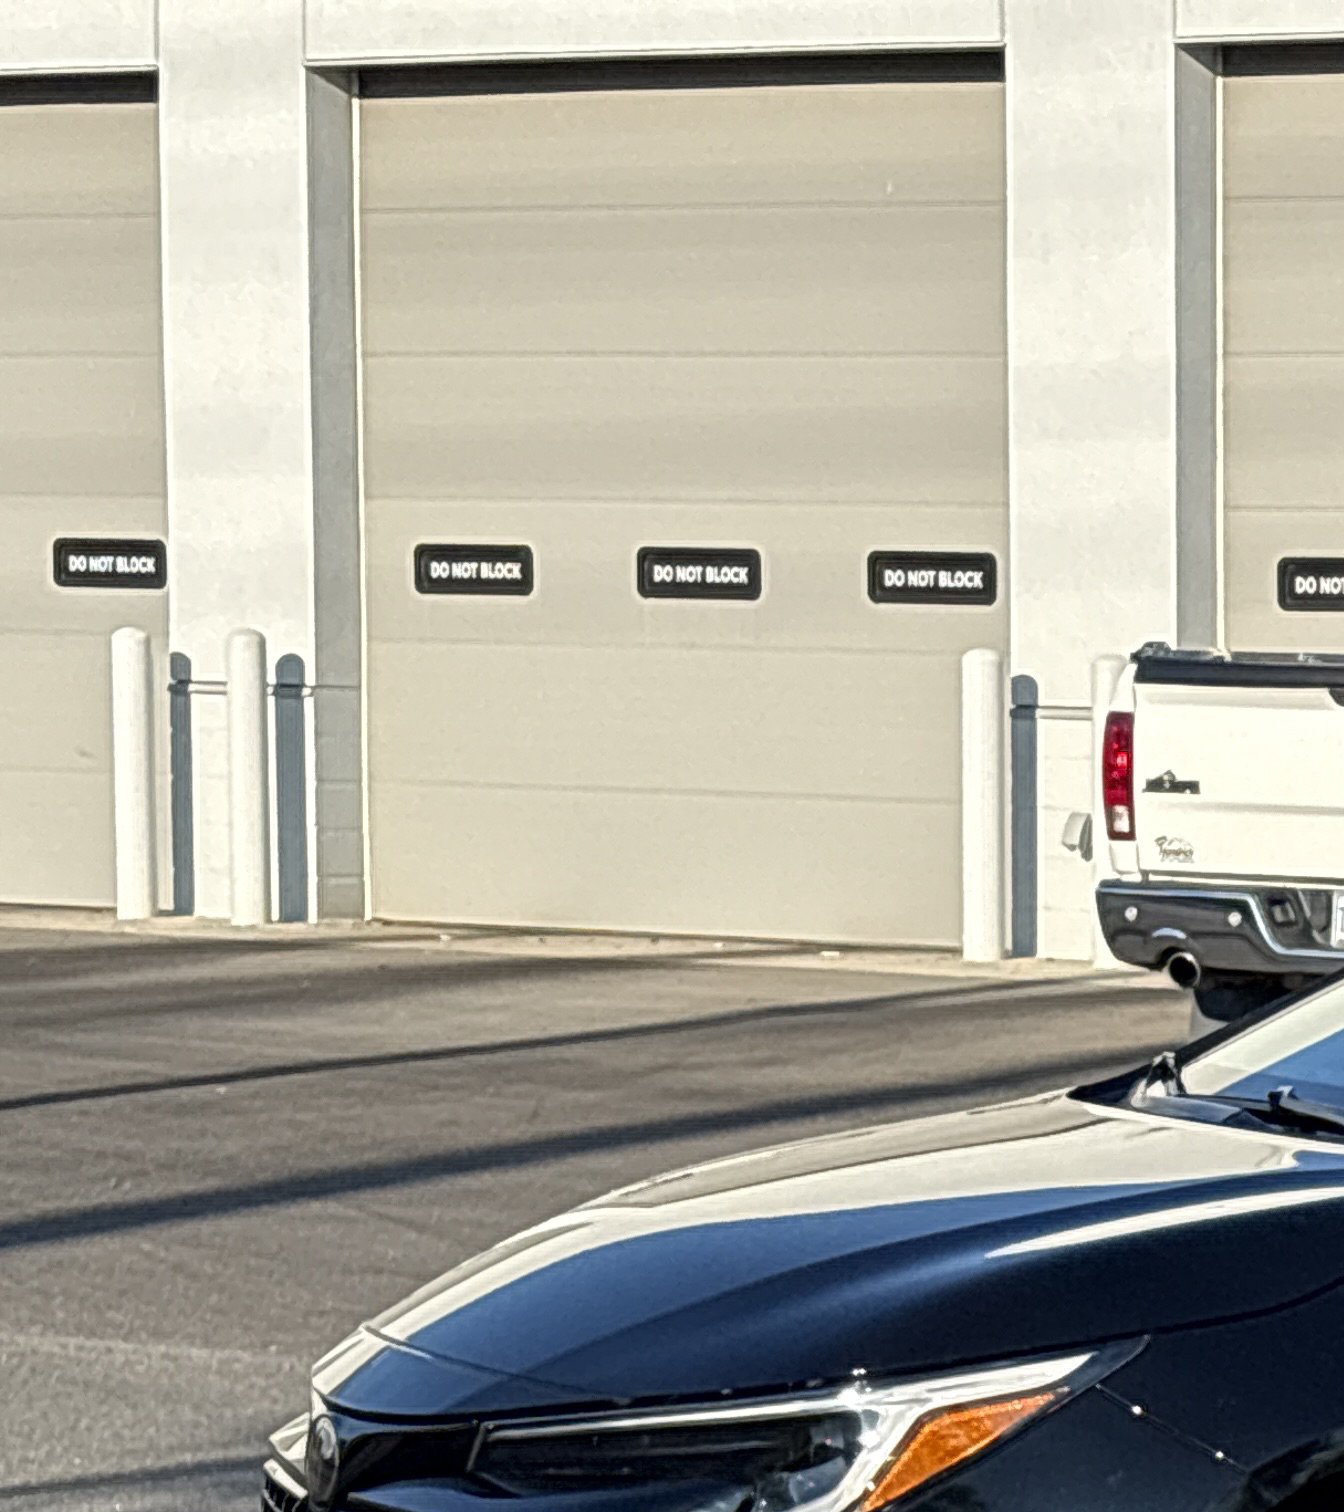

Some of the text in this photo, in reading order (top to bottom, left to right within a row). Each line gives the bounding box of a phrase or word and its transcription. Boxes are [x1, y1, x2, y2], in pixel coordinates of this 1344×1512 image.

[68, 555, 156, 574] DO NOT BLOCK
[430, 561, 522, 580] DO NOT BLOCK
[653, 564, 749, 585] DO NOT BLOCK
[884, 569, 983, 589] DO NOT BLOCK
[1295, 576, 1317, 594] DO
